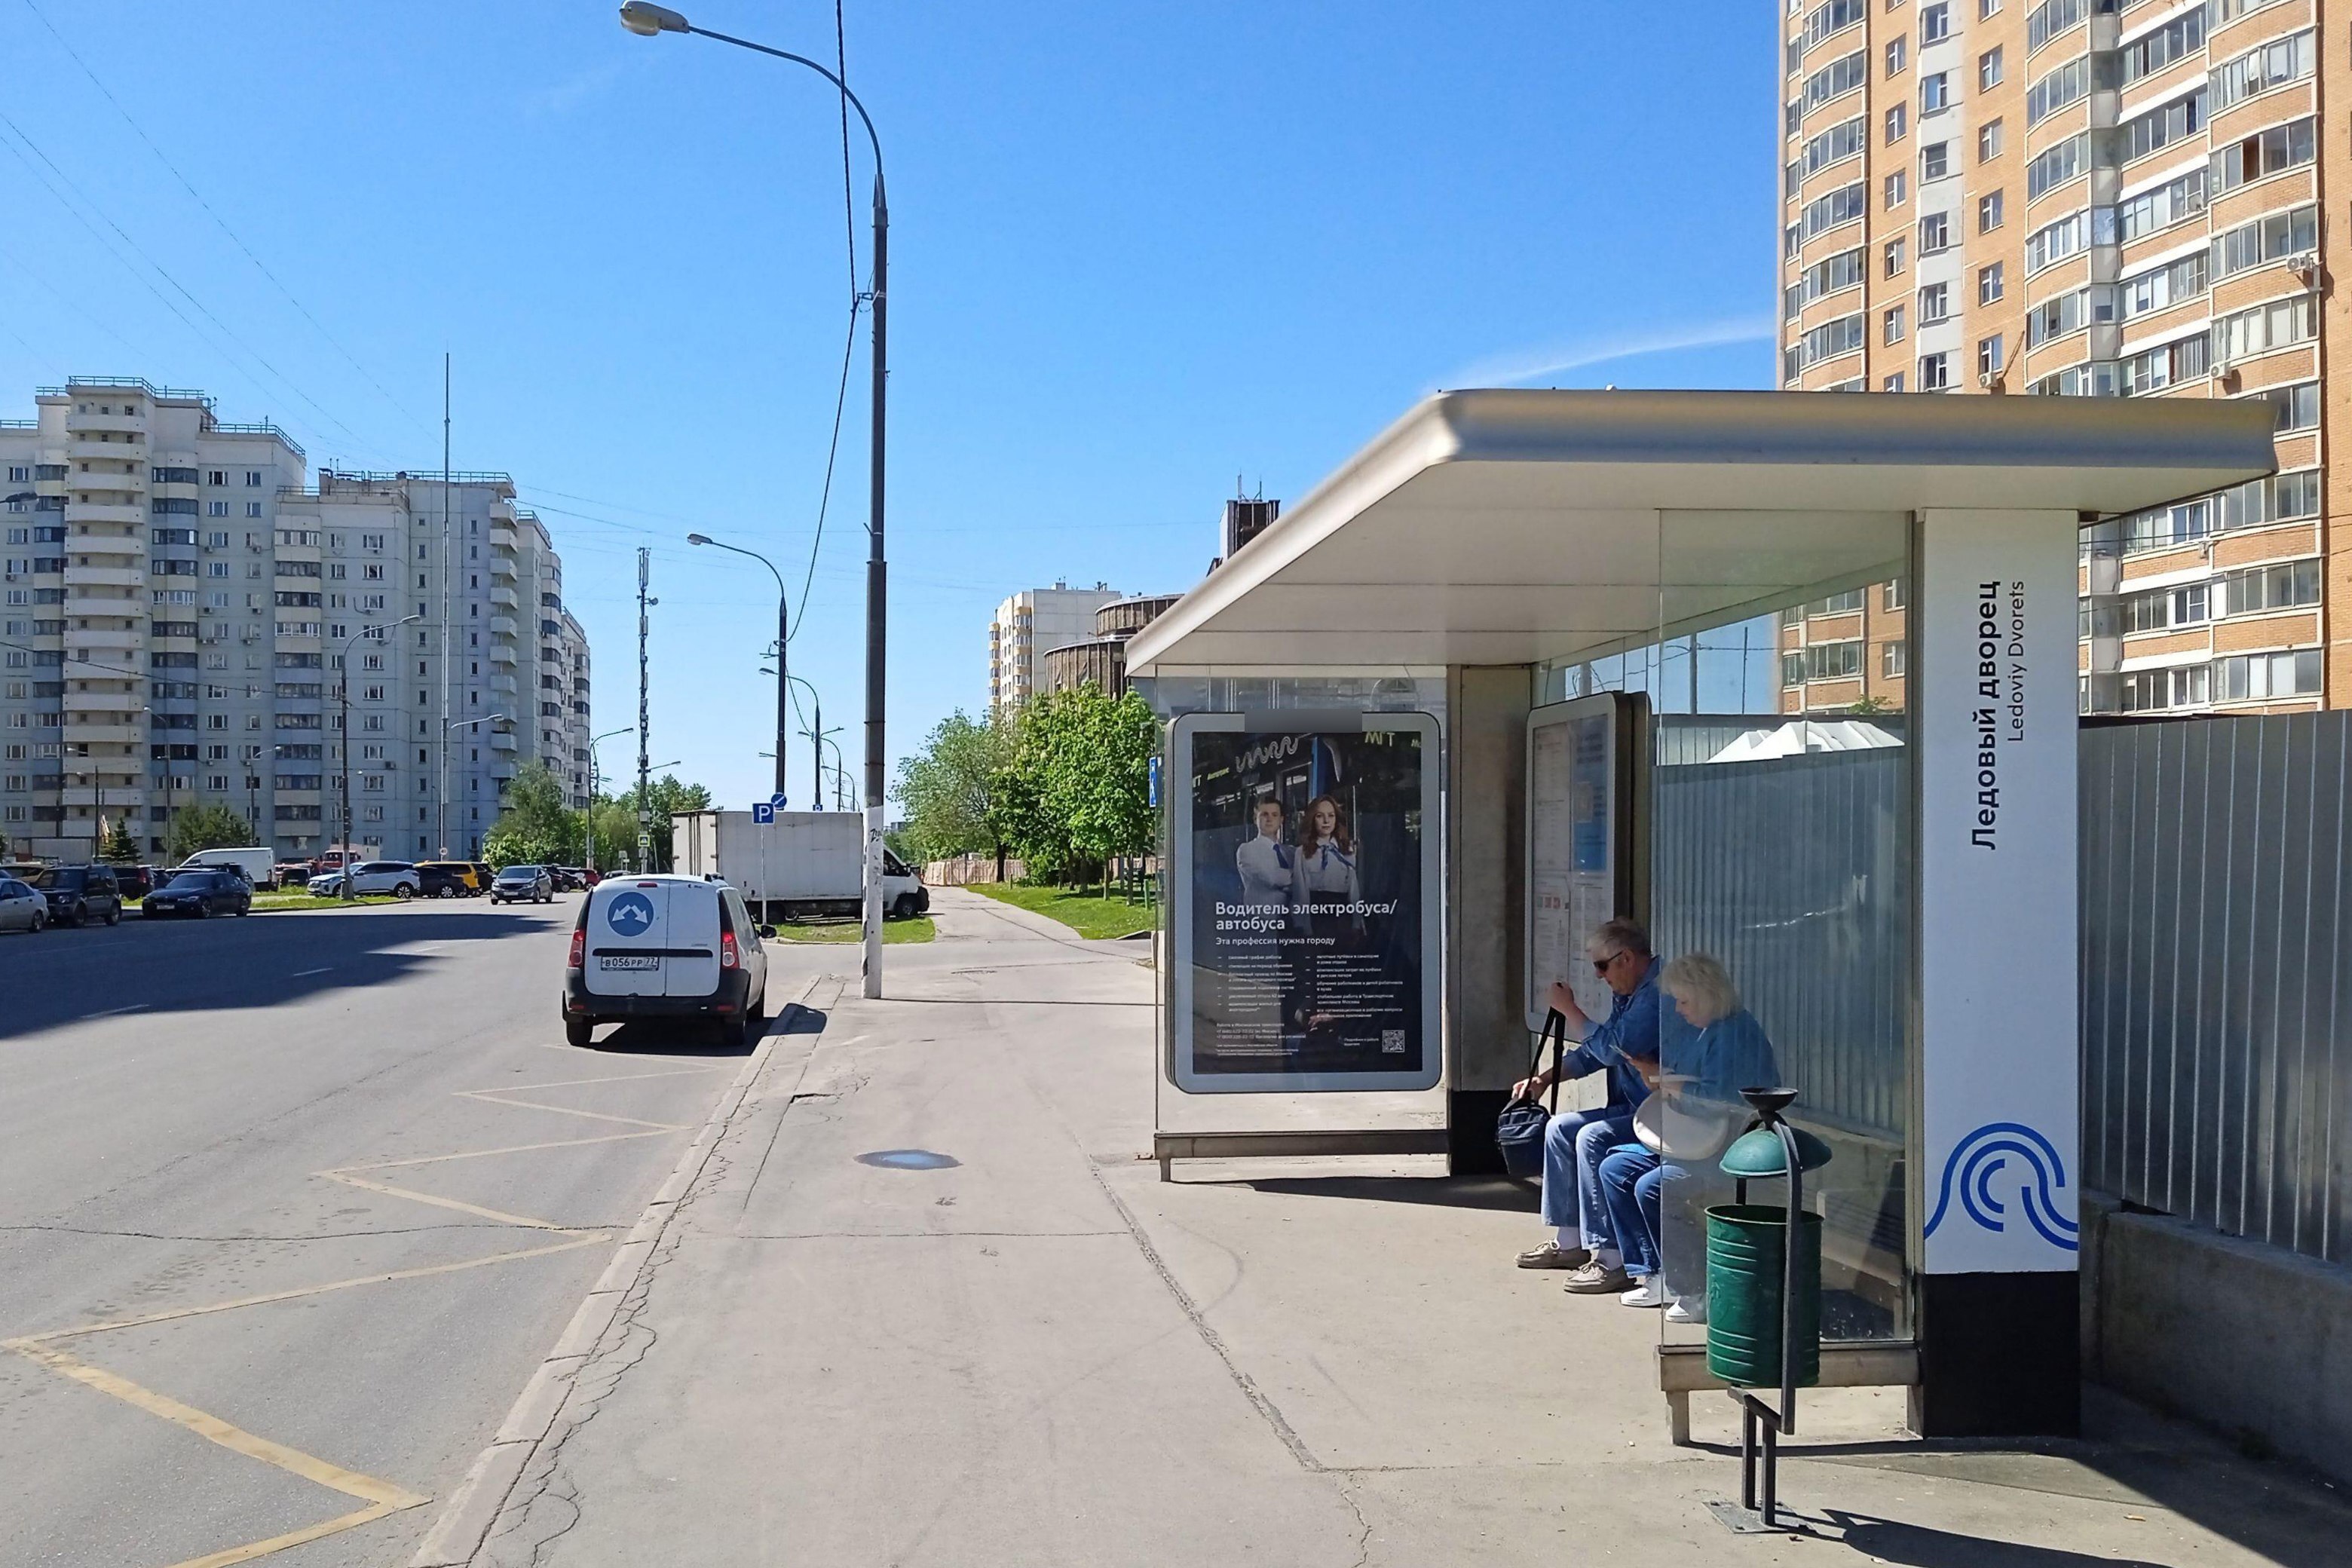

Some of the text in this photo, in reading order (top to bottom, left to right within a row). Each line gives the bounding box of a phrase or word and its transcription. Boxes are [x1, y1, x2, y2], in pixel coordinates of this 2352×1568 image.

[2007, 580, 2028, 742] Ledoviy Dvorets
[1971, 580, 2001, 850] Ледовый дворец
[758, 805, 771, 822] P
[1215, 899, 1398, 917] Водитель электробуса/
[1215, 917, 1285, 933] автобуса
[1215, 937, 1336, 946] Эта профессия нужна городу
